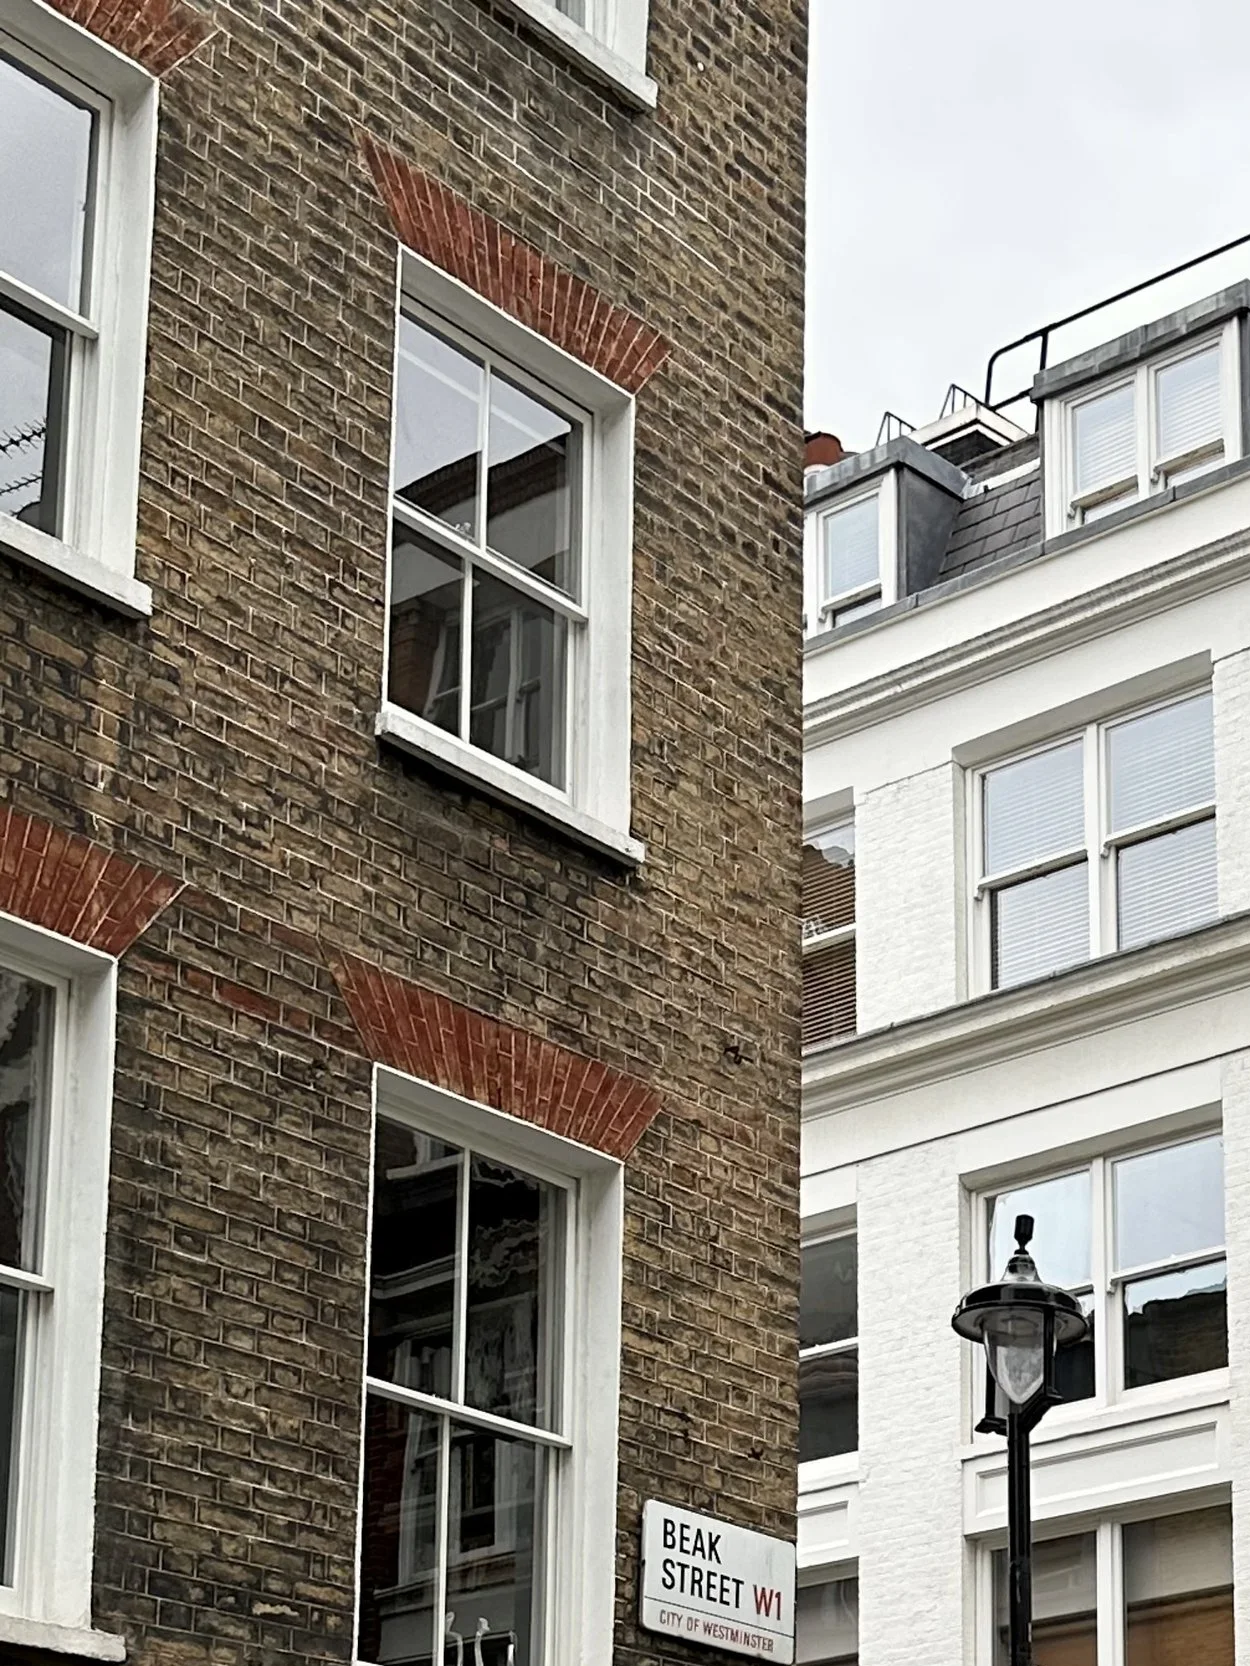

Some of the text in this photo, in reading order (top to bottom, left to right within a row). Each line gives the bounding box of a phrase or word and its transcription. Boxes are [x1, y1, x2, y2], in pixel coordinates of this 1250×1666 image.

[663, 1518, 722, 1564] BEAK
[661, 1558, 782, 1621] STREET W1
[659, 1609, 774, 1653] CITY OF WESTMINSTER
